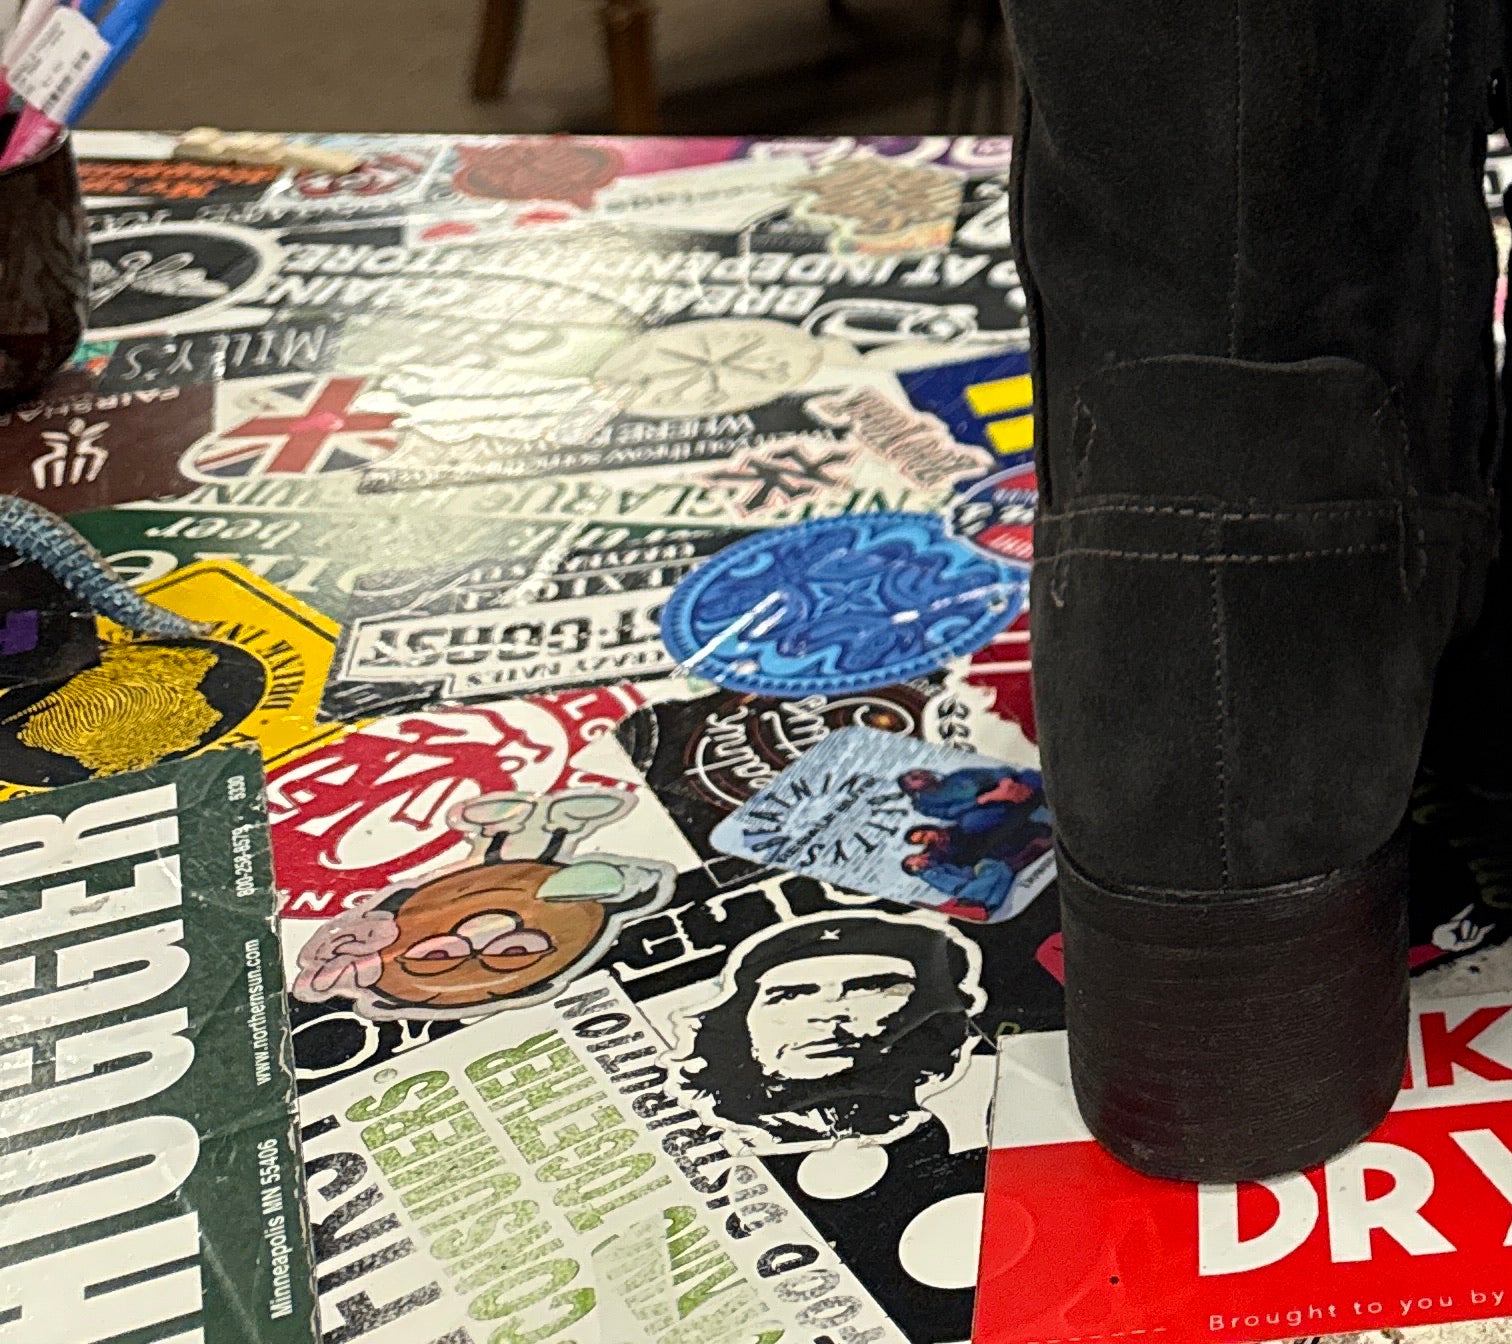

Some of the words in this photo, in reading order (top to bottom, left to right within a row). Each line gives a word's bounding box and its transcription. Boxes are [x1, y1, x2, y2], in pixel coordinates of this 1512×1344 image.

[145, 516, 299, 549] beer
[226, 774, 246, 801] 5330
[242, 937, 272, 1086] www.northernsun.com
[465, 1028, 674, 1231] TOGETHER
[256, 1138, 281, 1183] 55406
[263, 1186, 284, 1214] MN
[344, 1068, 598, 1344] CONSUMERS
[264, 1215, 294, 1320] Minneapolis
[1209, 1295, 1339, 1332] Brought
[1353, 1297, 1385, 1318] to
[1399, 1293, 1456, 1320] you
[1471, 1283, 1506, 1309] by
